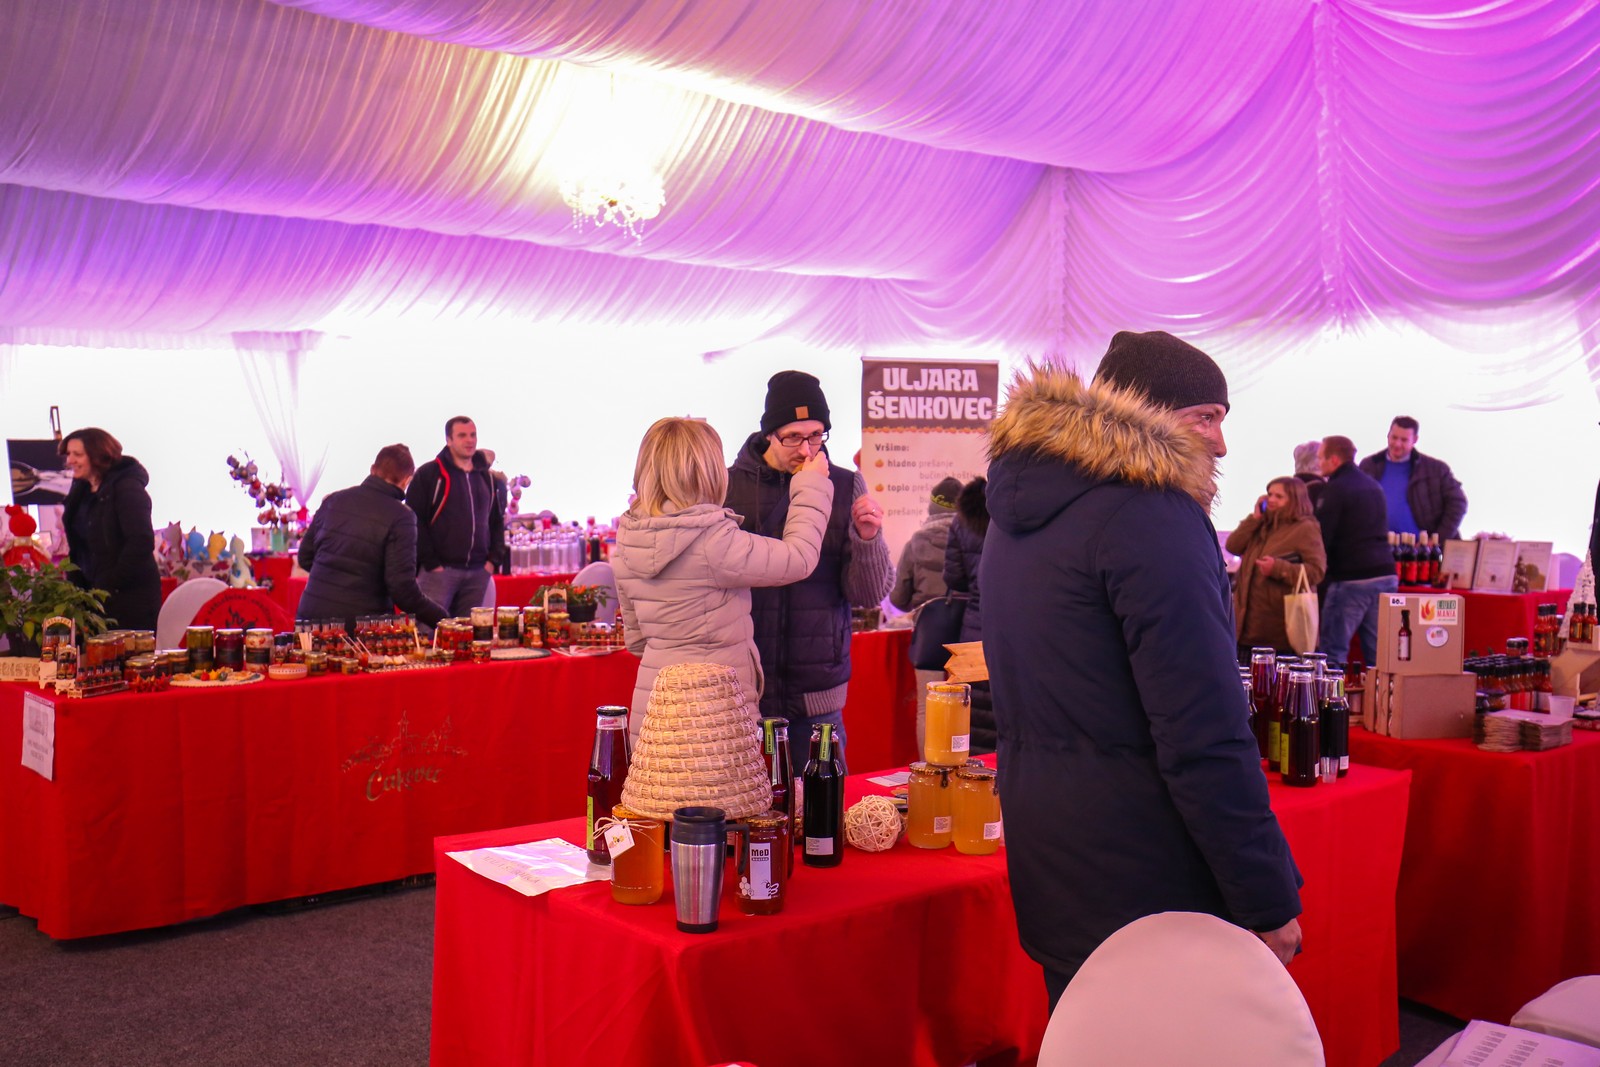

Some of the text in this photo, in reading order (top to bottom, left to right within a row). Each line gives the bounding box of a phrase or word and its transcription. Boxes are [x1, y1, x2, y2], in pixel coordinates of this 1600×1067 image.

[882, 367, 980, 392] ULJARA
[867, 390, 993, 420] ŠENKOVEC
[875, 443, 910, 452] Vršimo:
[888, 459, 953, 469] hladno prešanje
[888, 483, 910, 492] toplo
[888, 506, 923, 518] prešanje
